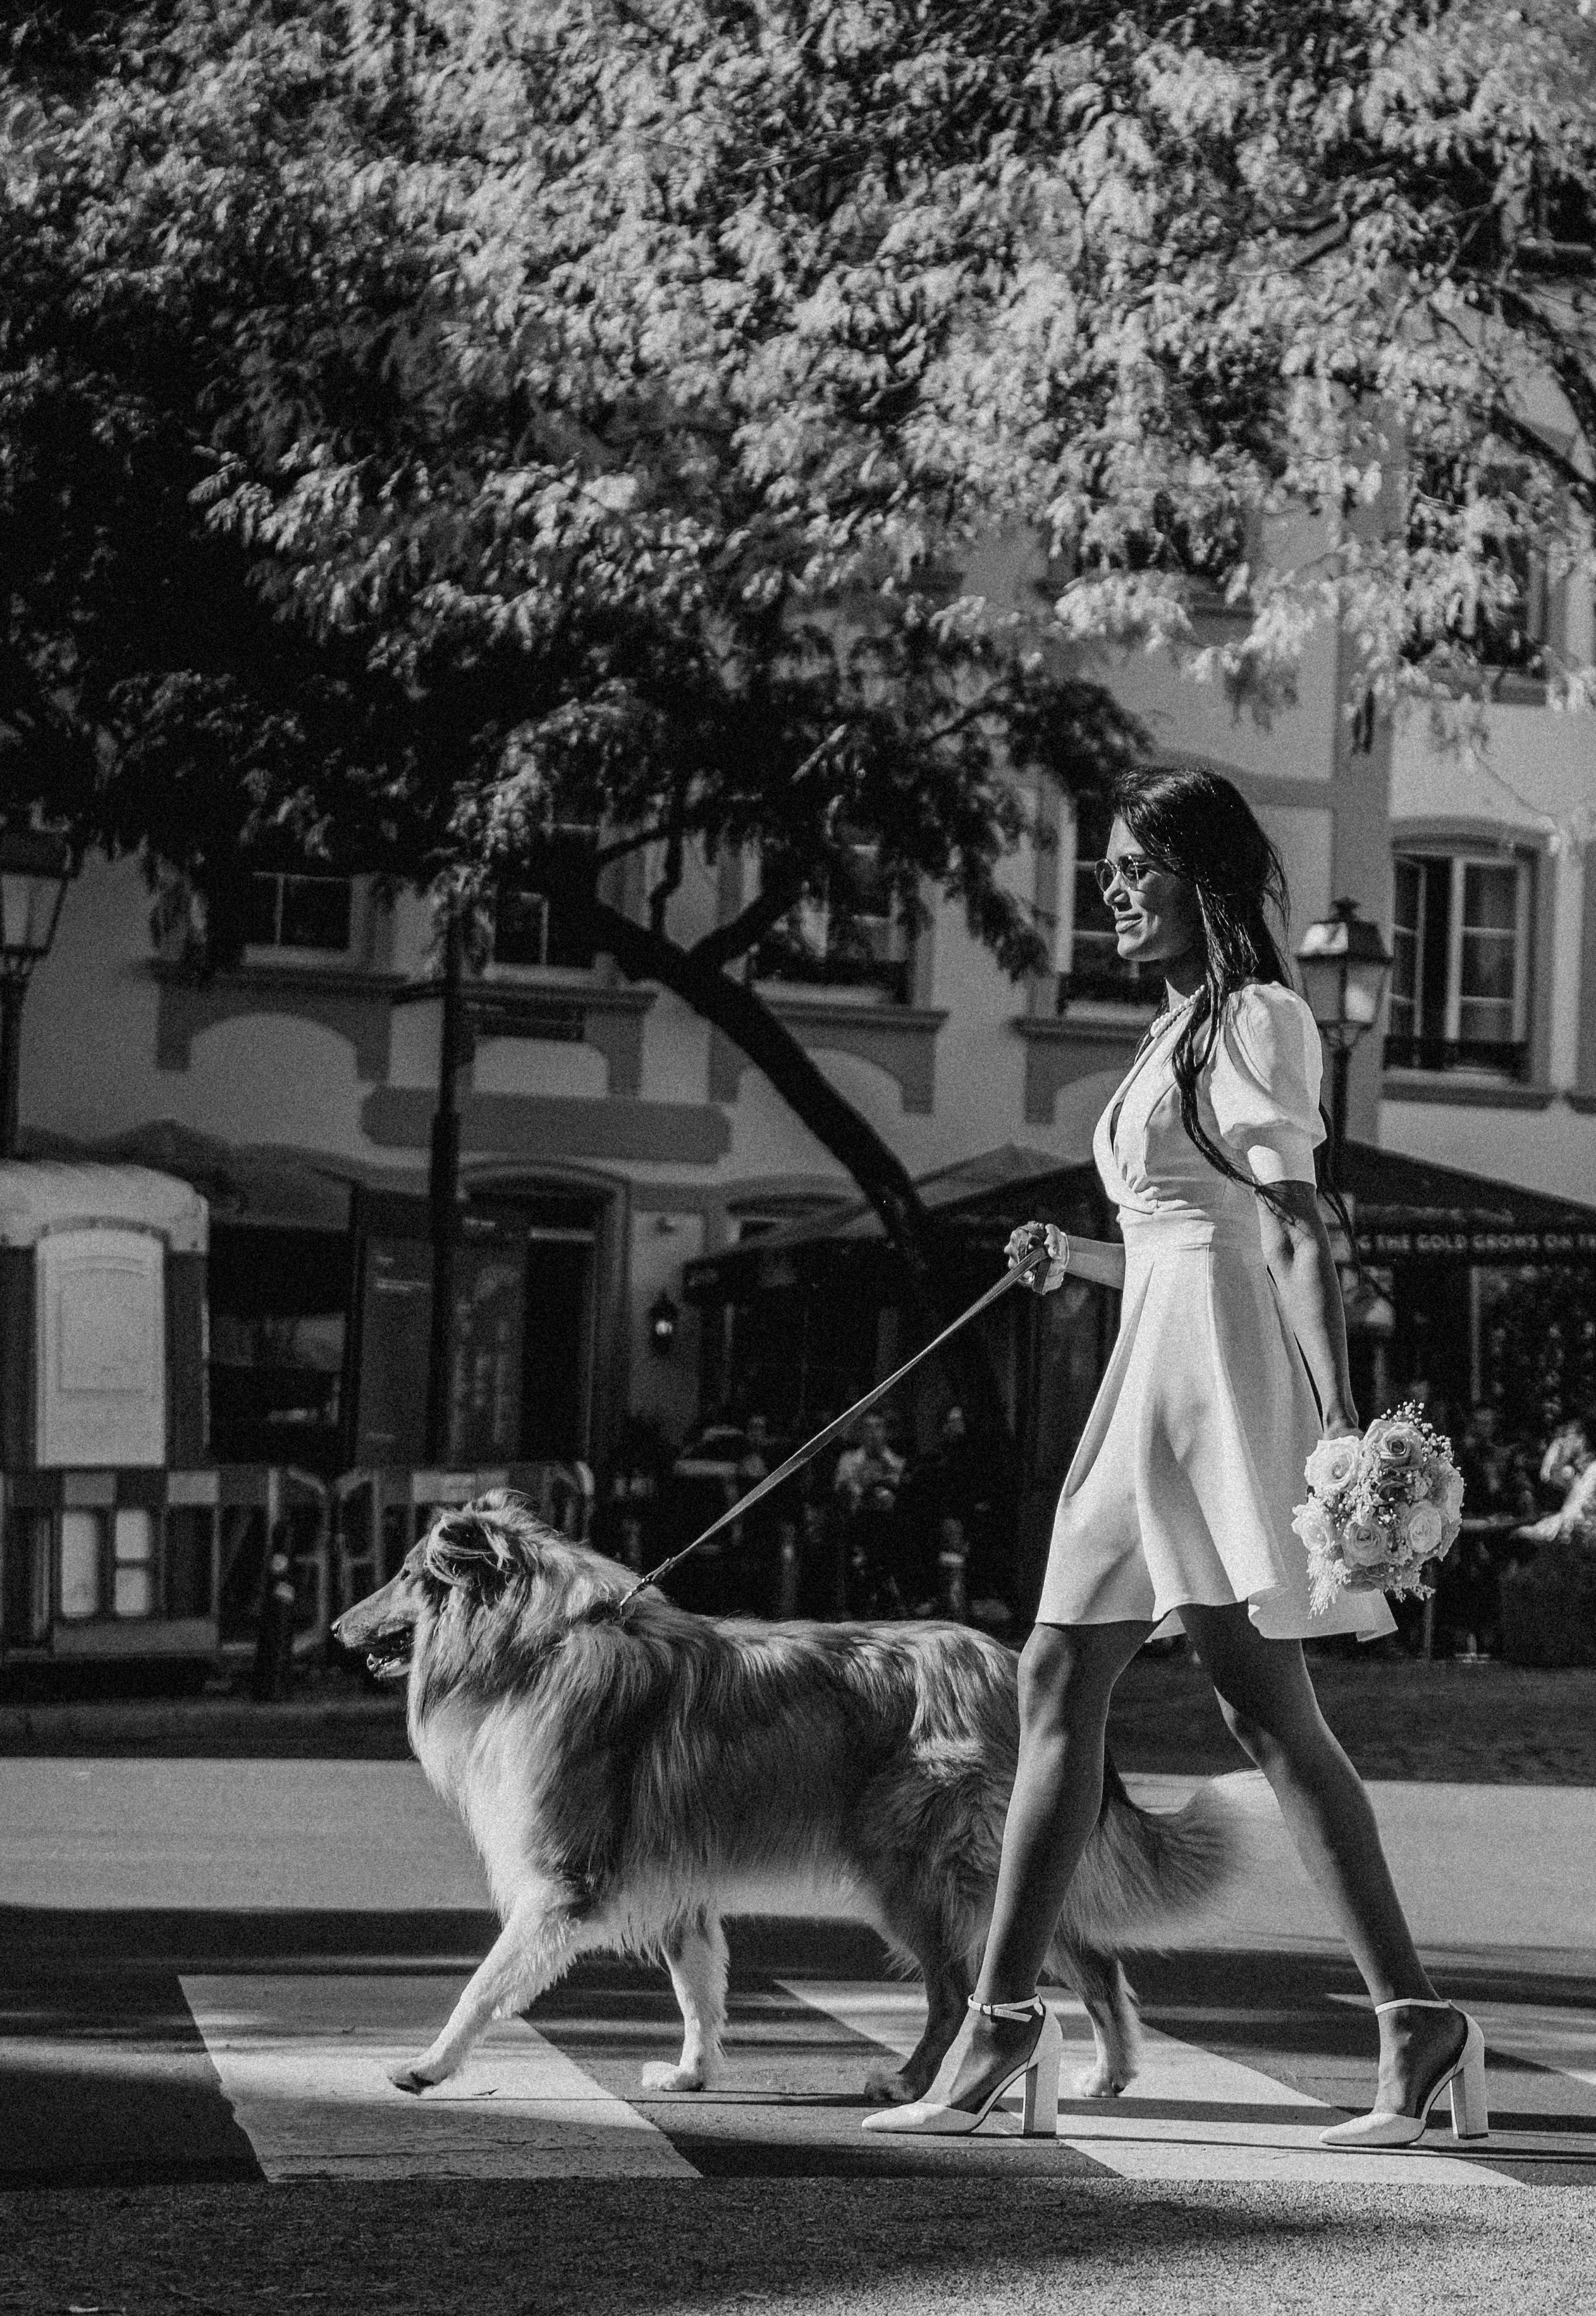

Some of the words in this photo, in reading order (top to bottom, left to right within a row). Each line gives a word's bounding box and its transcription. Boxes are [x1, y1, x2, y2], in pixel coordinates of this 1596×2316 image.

[1416, 1234, 1466, 1250] GOLD
[1473, 1234, 1538, 1250] GROWS
[1544, 1234, 1573, 1250] ON
